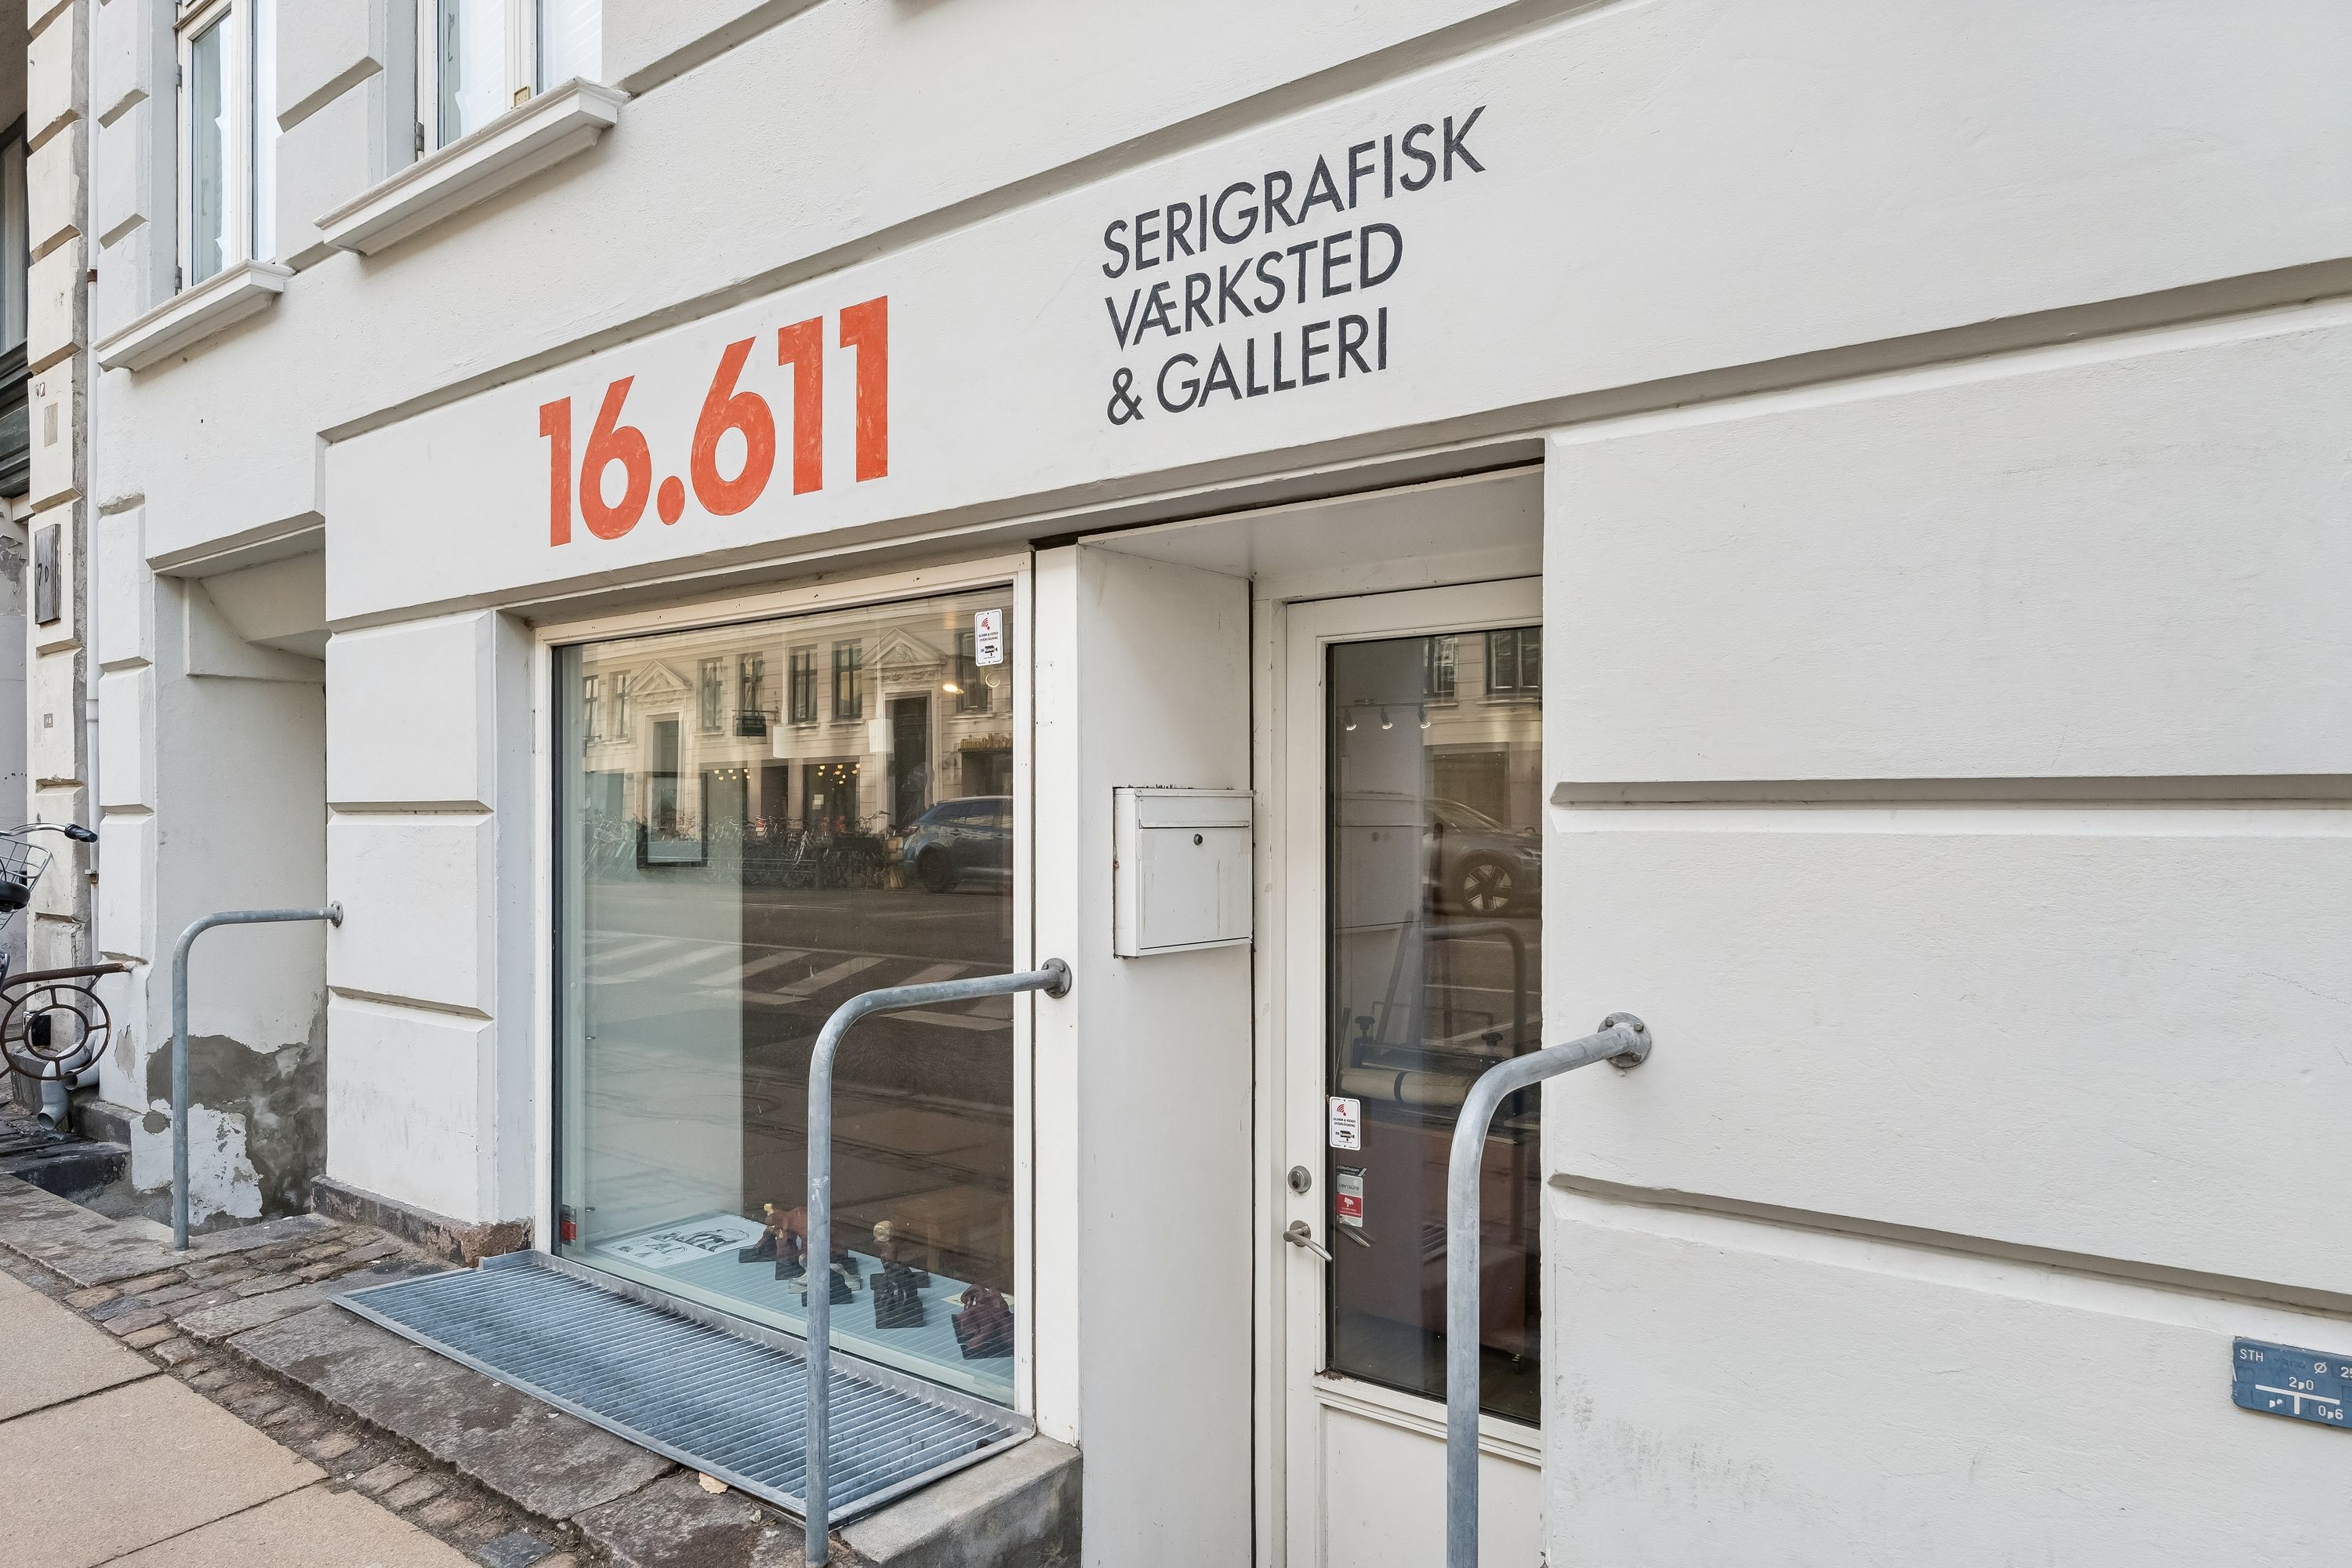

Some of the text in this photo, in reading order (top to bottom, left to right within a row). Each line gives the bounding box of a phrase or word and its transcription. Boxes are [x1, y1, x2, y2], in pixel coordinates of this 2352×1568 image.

[1102, 105, 1486, 278] SERIGRAFISK
[1104, 223, 1403, 351] VÆRKSTED
[539, 296, 888, 547] 16.611
[1106, 307, 1387, 426] & GALLERI
[2239, 1348, 2264, 1363] STH
